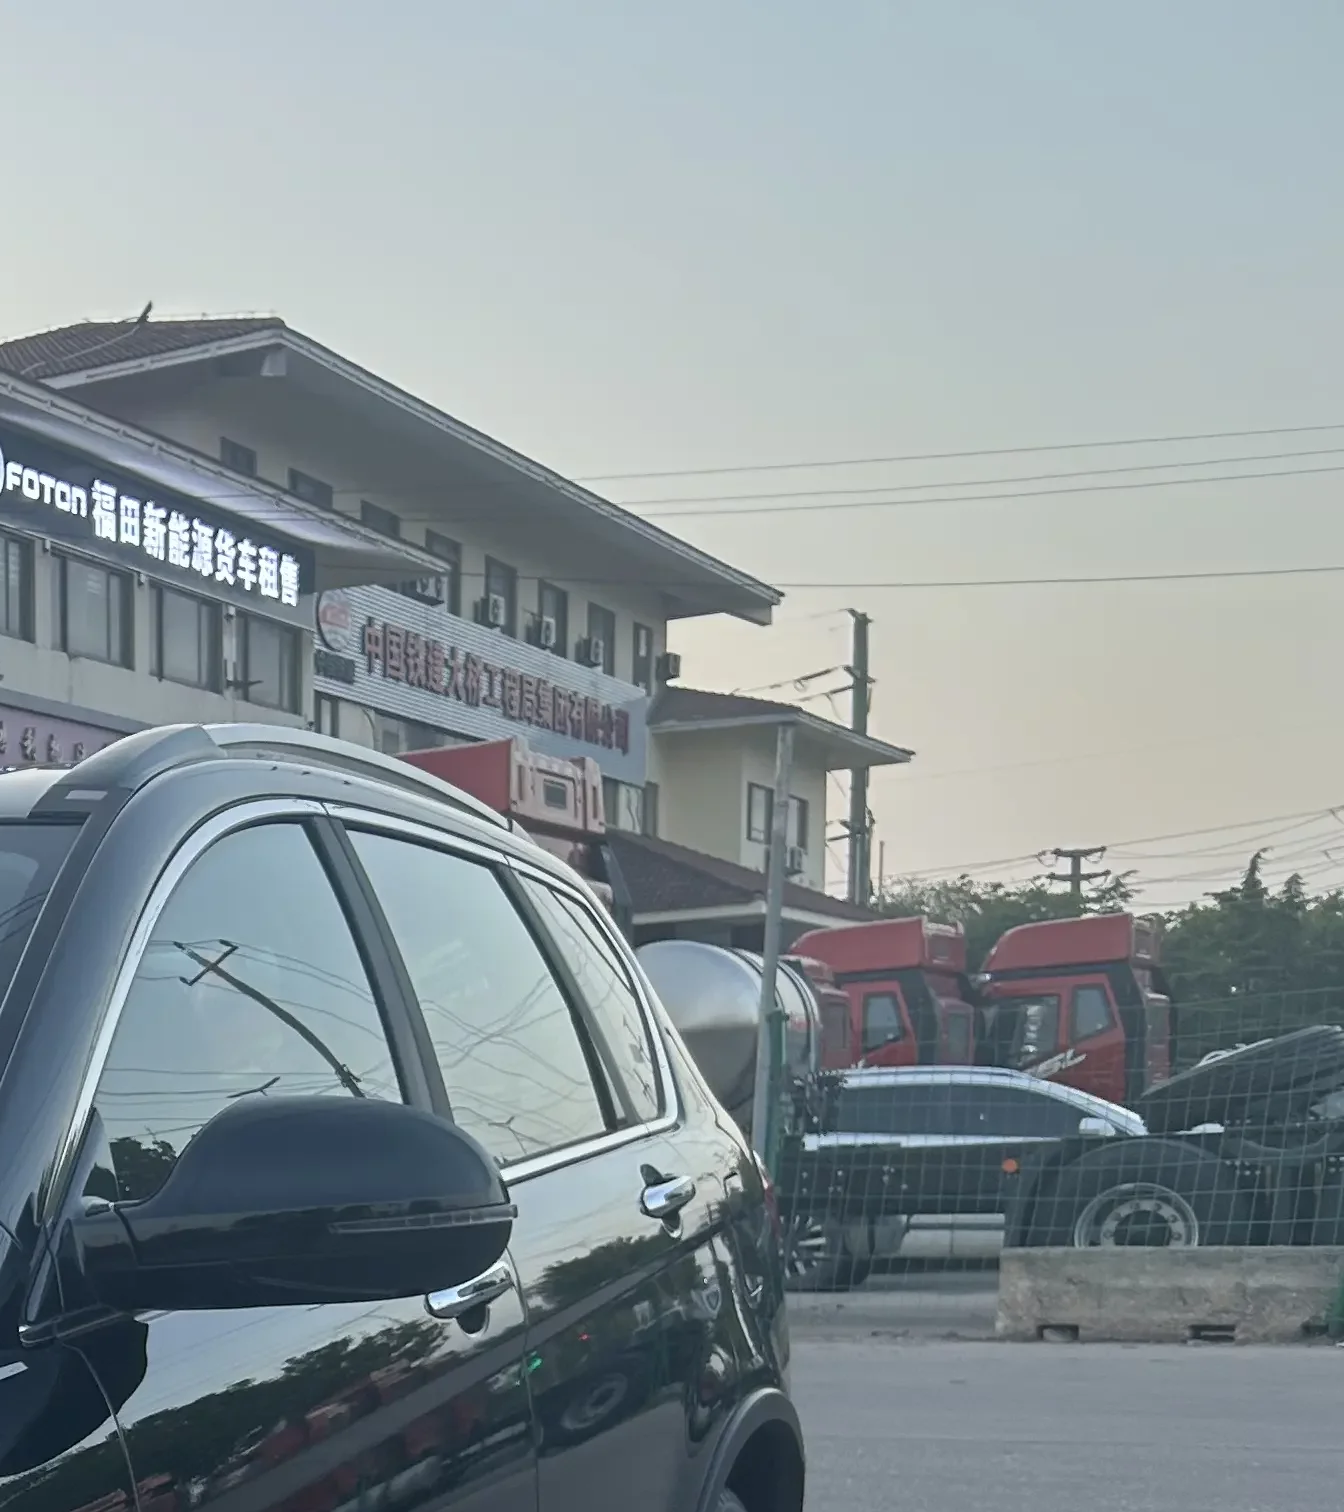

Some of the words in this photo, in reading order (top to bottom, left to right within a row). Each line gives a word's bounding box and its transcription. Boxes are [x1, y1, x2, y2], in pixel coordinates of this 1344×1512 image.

[6, 461, 88, 518] FOTON
[92, 478, 300, 607] 福田新能源货车租售
[364, 616, 630, 755] 中国铁建大桥工程局集团有限公司
